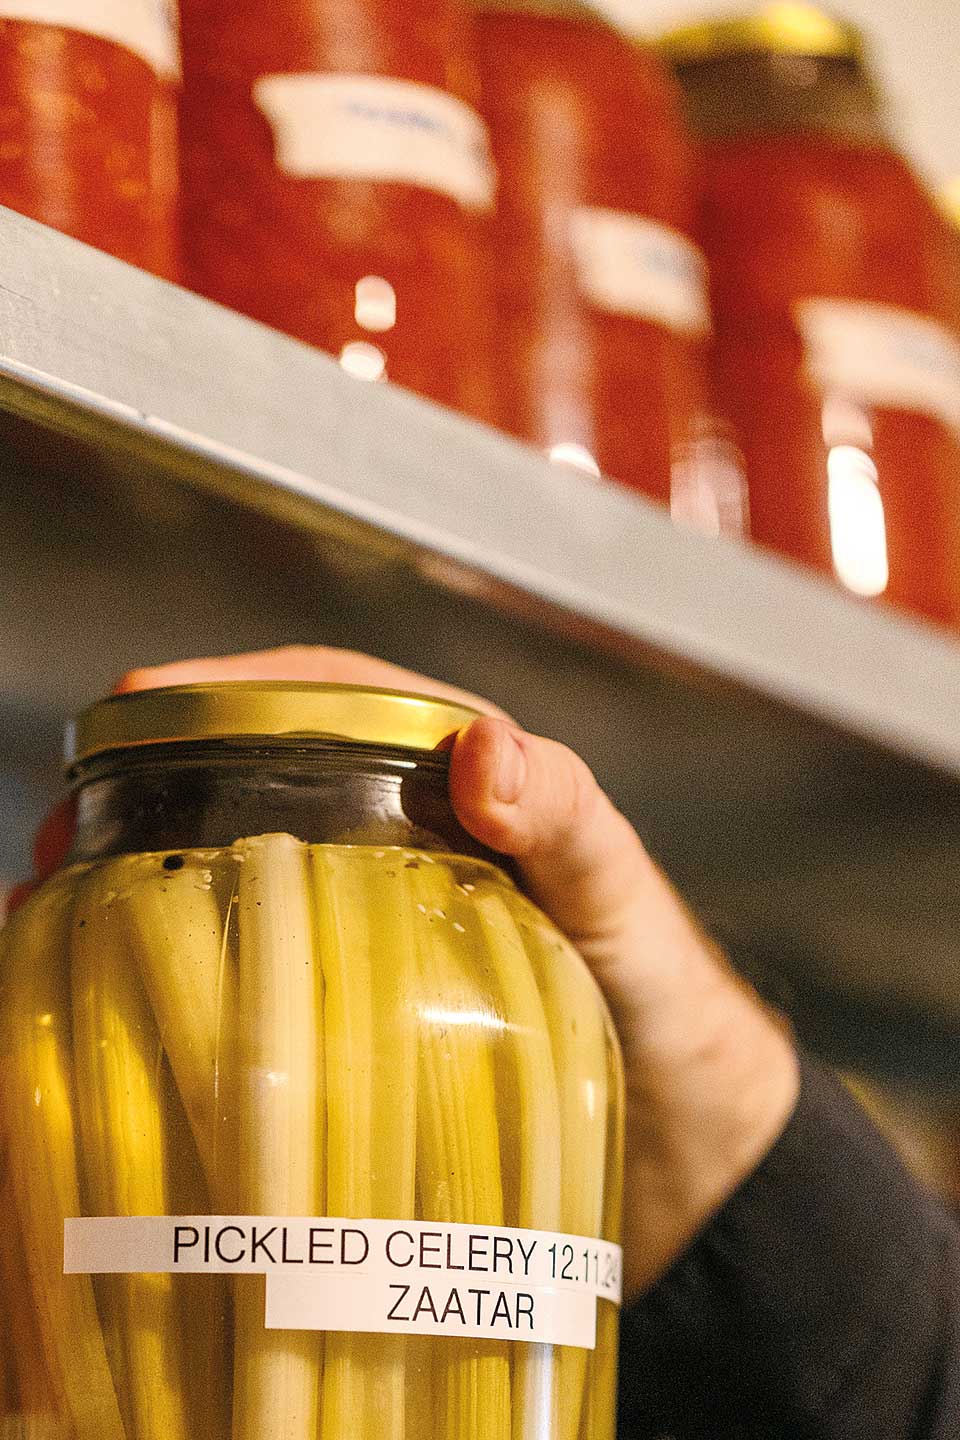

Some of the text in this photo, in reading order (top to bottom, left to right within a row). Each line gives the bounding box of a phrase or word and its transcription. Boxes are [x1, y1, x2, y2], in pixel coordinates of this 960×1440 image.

[172, 1225, 370, 1266] PICKLED
[384, 1231, 538, 1276] CELERY
[387, 1284, 536, 1331] ZAATAR
